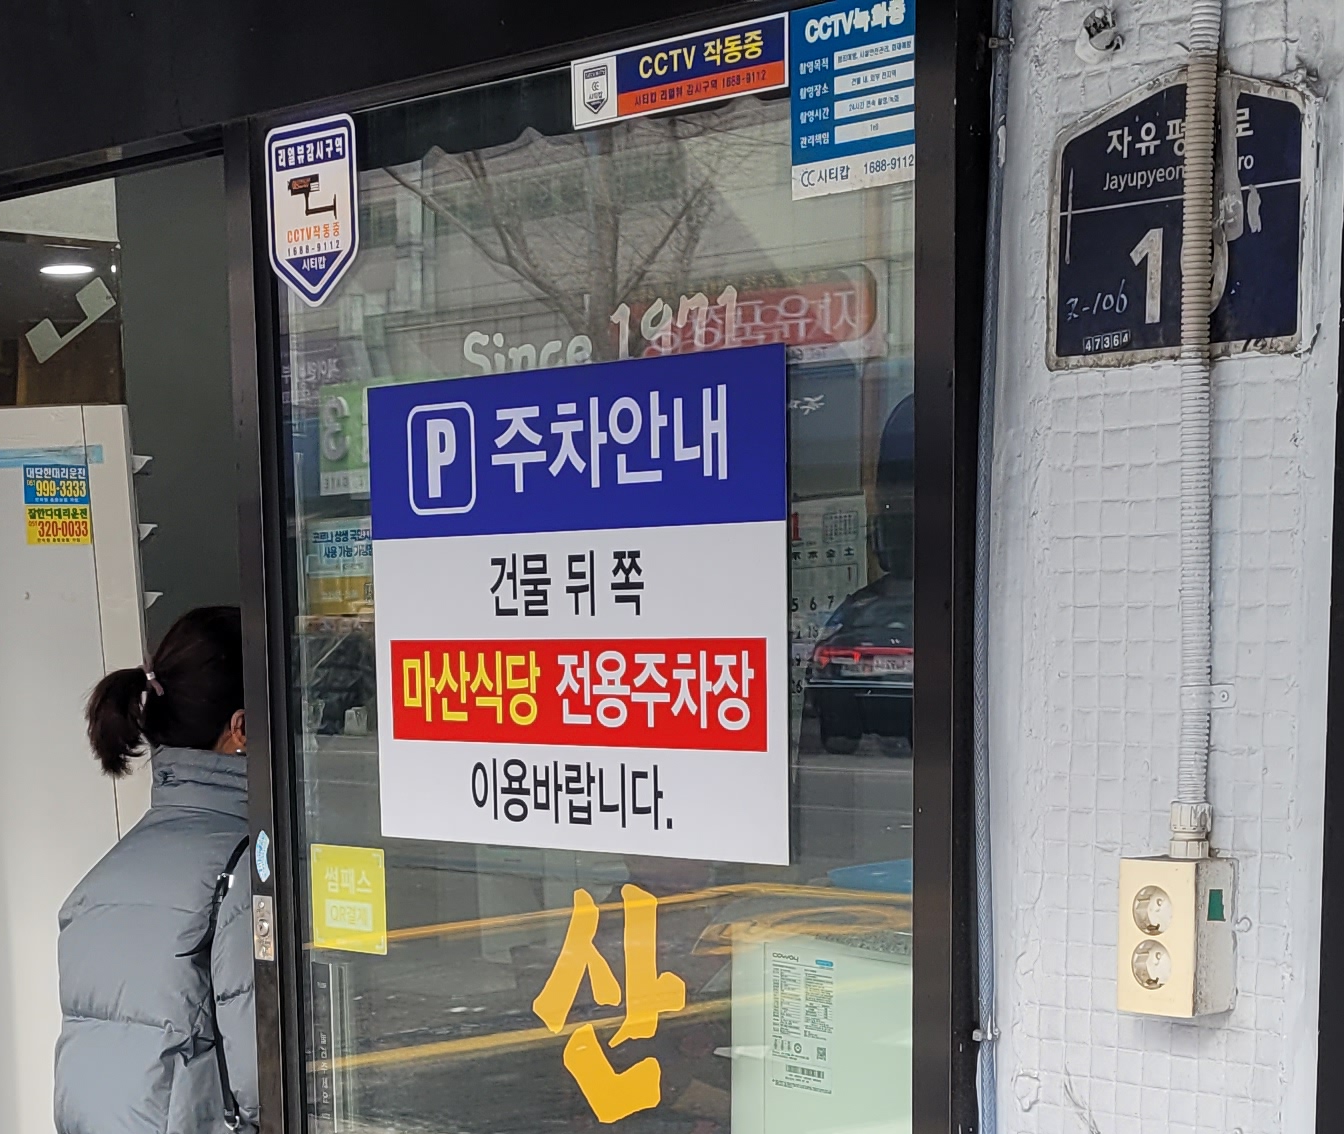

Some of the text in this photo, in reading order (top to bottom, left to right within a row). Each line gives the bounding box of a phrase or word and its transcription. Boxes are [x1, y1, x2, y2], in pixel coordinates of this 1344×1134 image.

[639, 29, 764, 80] CCTV 작동중
[1106, 106, 1254, 159] 자유평로
[817, 164, 850, 184] 시티캅
[863, 153, 915, 175] 1688-9112
[287, 220, 341, 244] CCTV작동중
[287, 239, 341, 258] 1688-9112
[301, 255, 328, 272] 시티캅
[462, 328, 594, 374] Since
[1084, 332, 1129, 352] 47364
[426, 382, 729, 499] P 주차안내
[35, 479, 87, 498] 999-3333
[37, 520, 89, 538] 320-0033
[488, 548, 647, 618] 건물 뒤 쪽
[809, 596, 818, 611] 6
[401, 648, 756, 731] 마산식당 전용주차장
[470, 756, 675, 831] 이용바랍니다.
[325, 865, 373, 895] 썸패스
